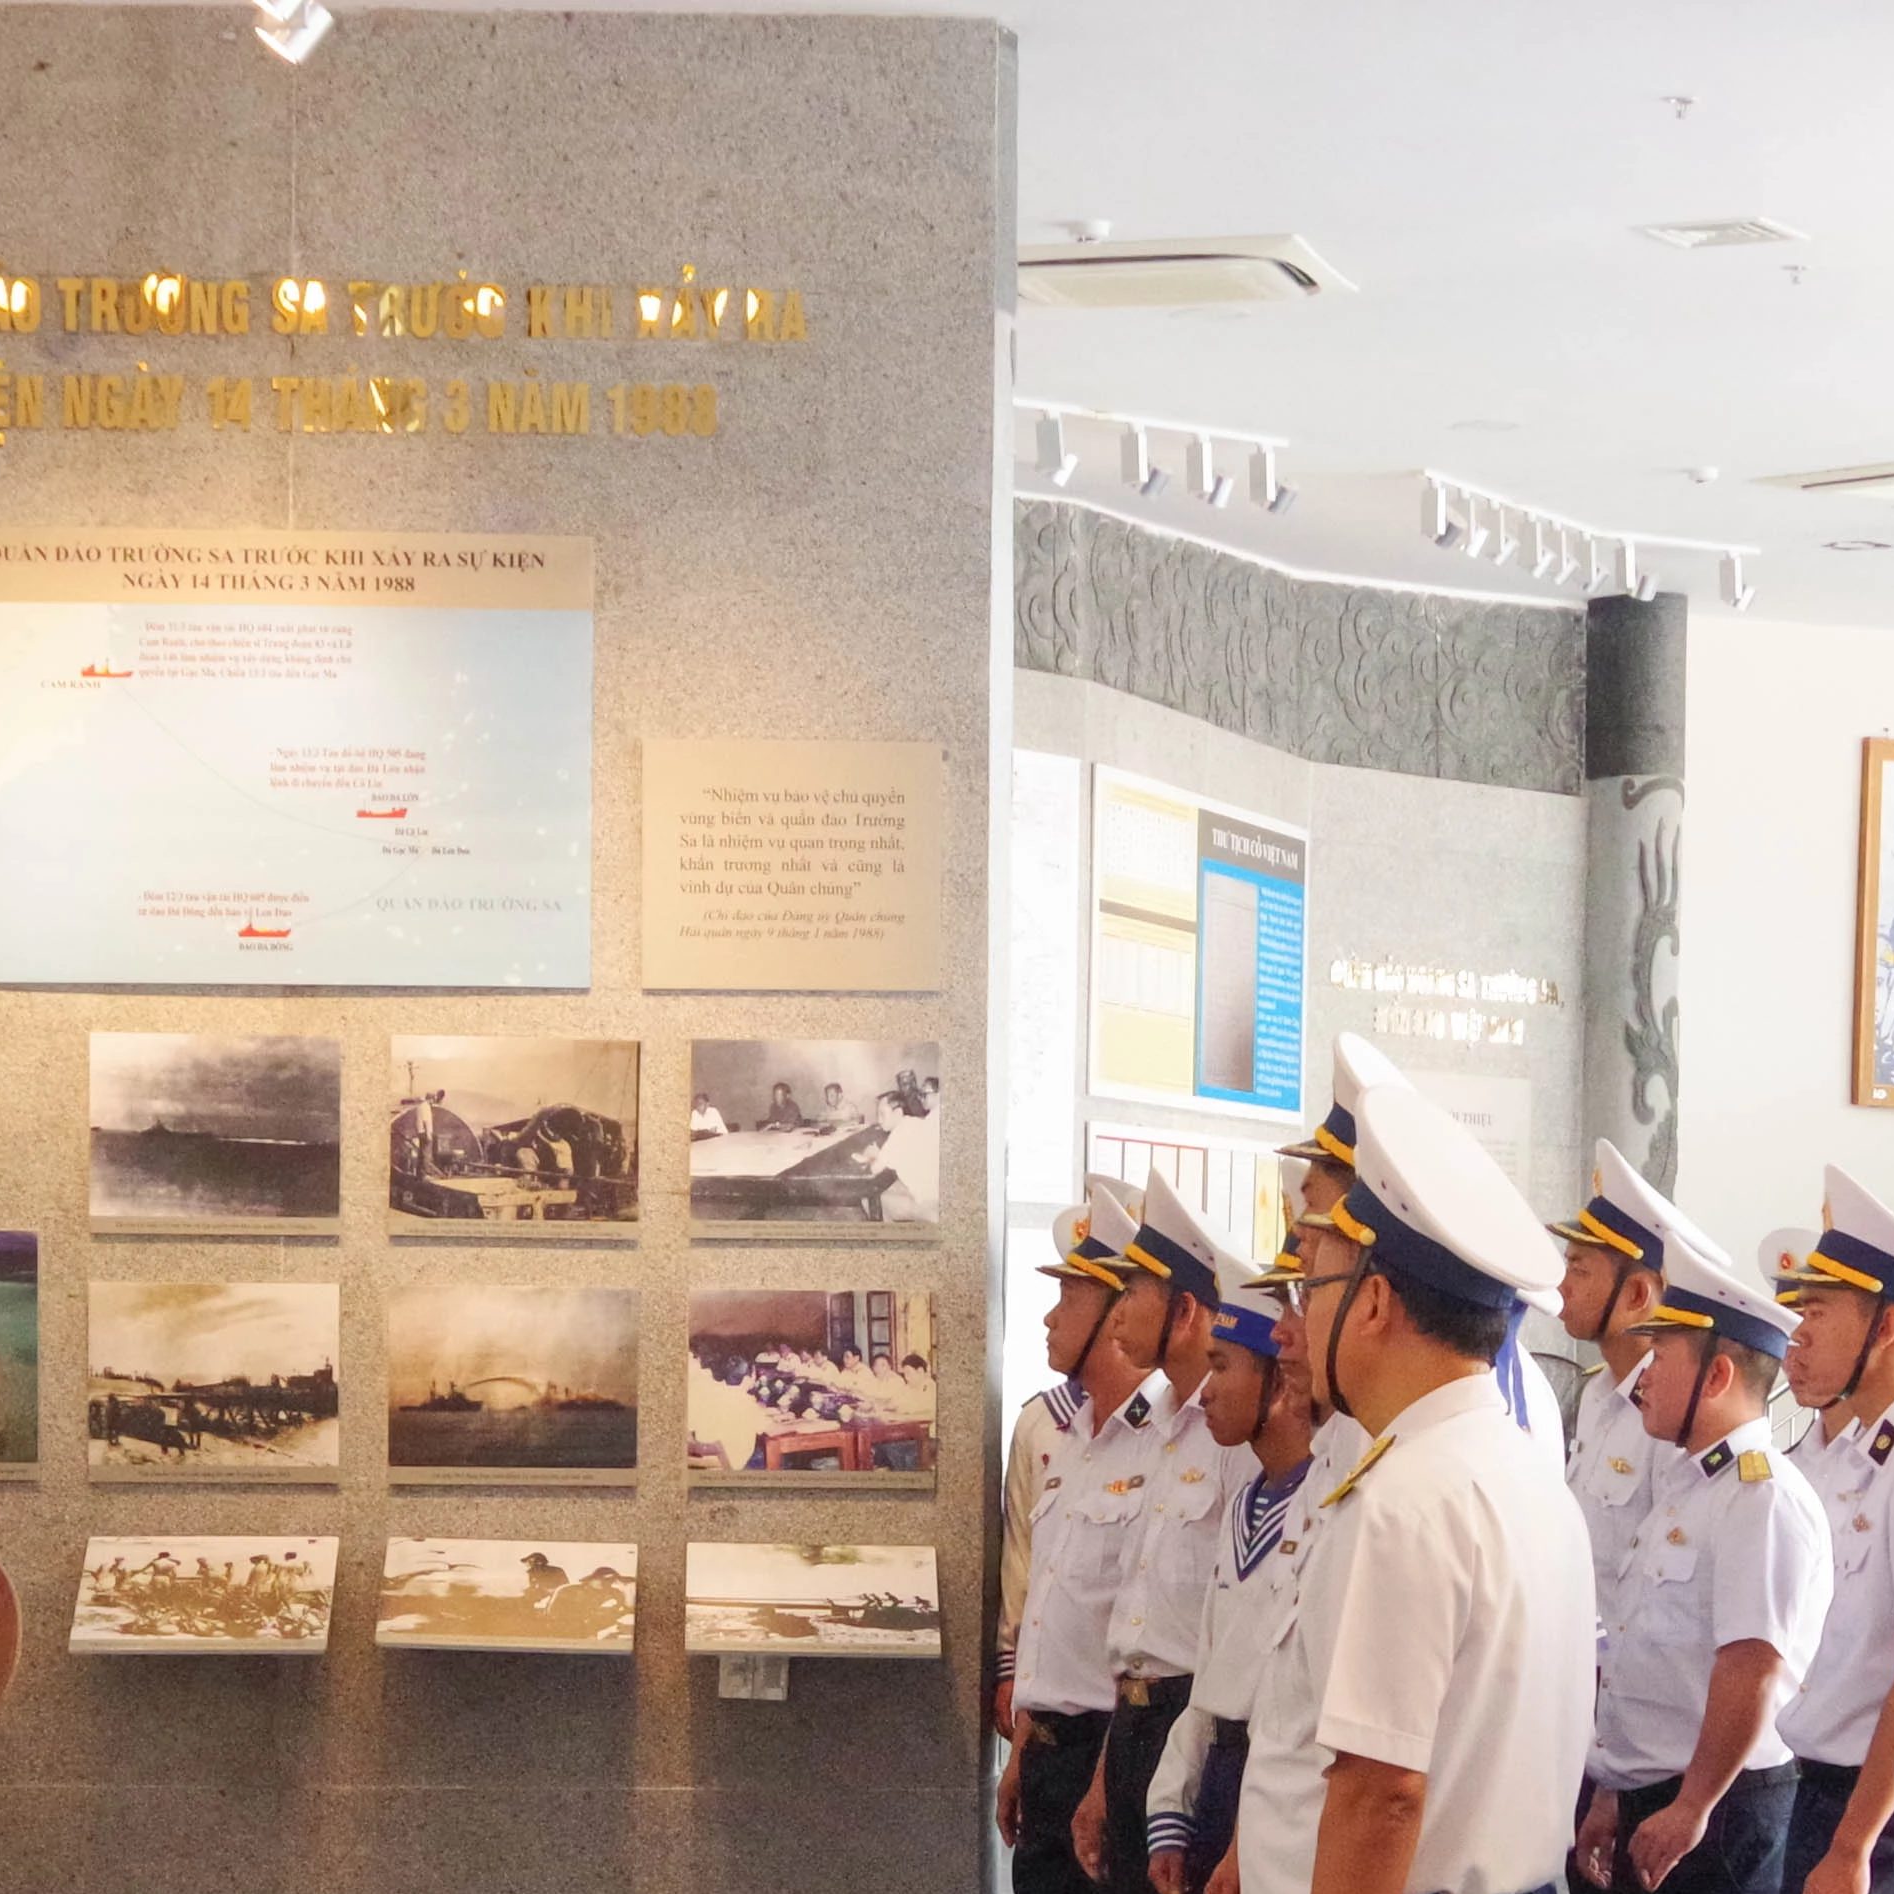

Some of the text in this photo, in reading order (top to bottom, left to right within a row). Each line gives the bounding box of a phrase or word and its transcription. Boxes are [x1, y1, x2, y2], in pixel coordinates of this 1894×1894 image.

[273, 277, 328, 336] SA
[526, 285, 611, 340] KHI
[746, 288, 808, 341] RA
[63, 360, 186, 430] NGÀY
[207, 377, 253, 432] 14
[272, 363, 427, 434] THÁNG
[445, 379, 470, 432] 3
[608, 383, 718, 436] 1988
[108, 543, 202, 564] TRƯỜNG
[208, 548, 235, 564] SA
[325, 549, 364, 566] KHI
[423, 551, 451, 567] RA
[123, 568, 185, 589] NGÀY
[191, 574, 210, 589] 14
[217, 569, 294, 591] THÁNG
[300, 575, 309, 591] 3
[374, 576, 416, 592] 1988
[679, 834, 697, 848] Sa
[702, 834, 714, 848] là
[789, 839, 824, 852] quan
[893, 860, 904, 873] là
[1281, 849, 1298, 870] NAM
